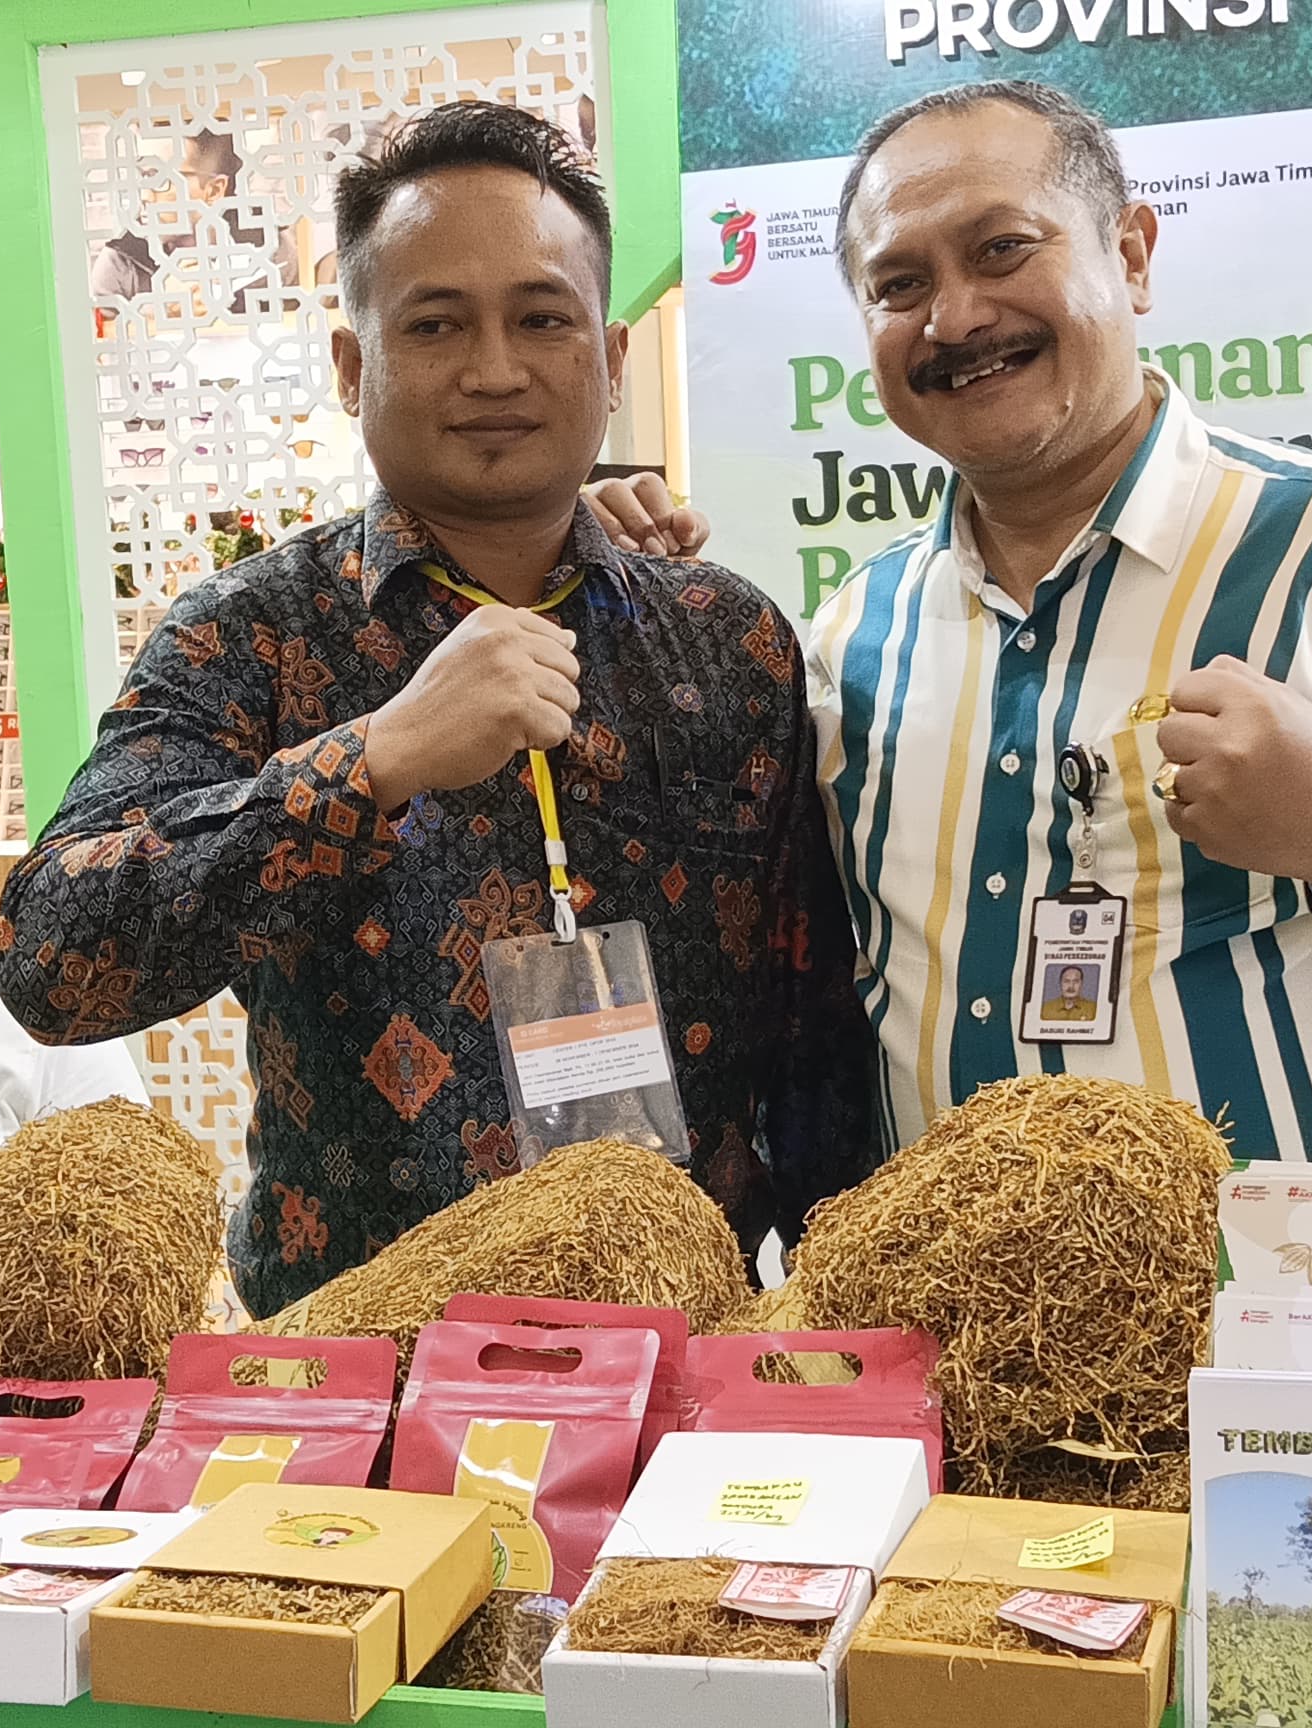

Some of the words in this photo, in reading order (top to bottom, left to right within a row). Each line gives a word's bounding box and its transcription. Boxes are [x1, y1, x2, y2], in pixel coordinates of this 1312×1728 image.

[1216, 170, 1270, 188] Jawa
[767, 210, 799, 222] JAWA
[767, 222, 817, 235] BERSATU
[768, 235, 823, 248] BERSAMA
[768, 249, 806, 260] UNTUK
[791, 450, 948, 527] Jaw
